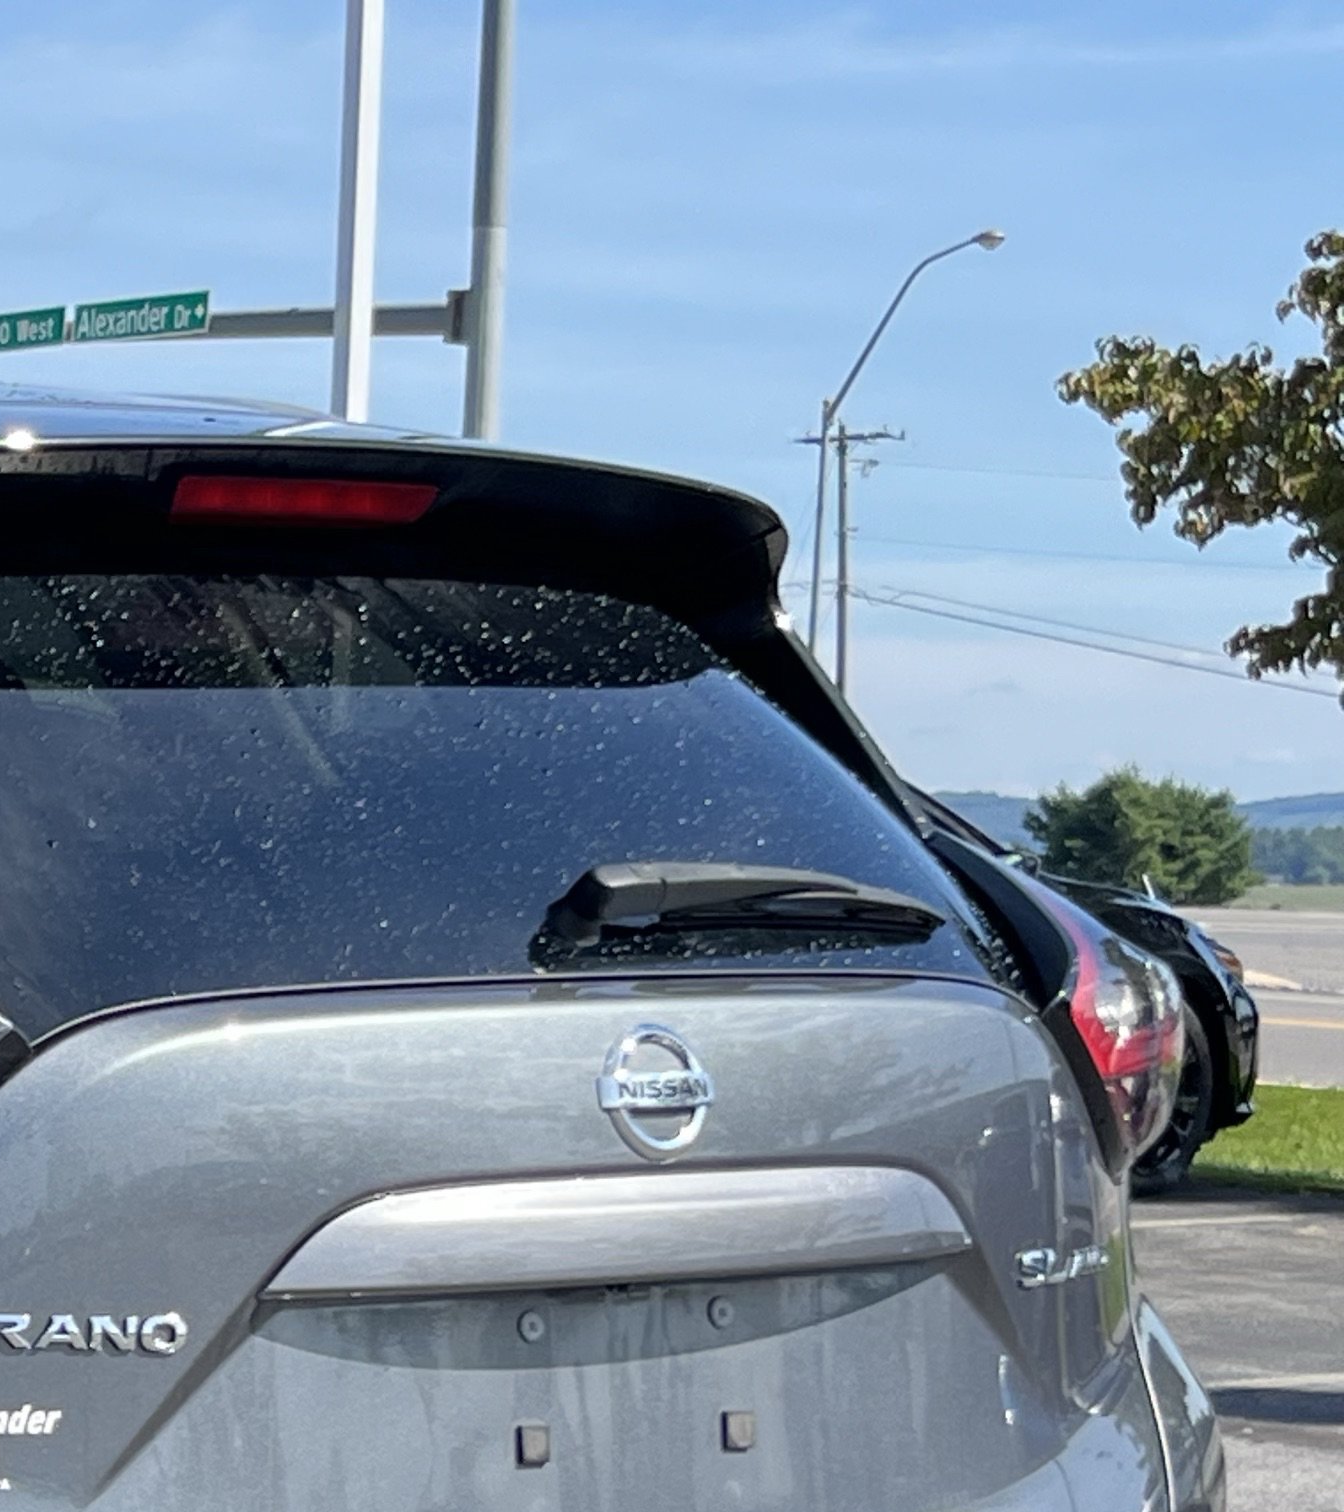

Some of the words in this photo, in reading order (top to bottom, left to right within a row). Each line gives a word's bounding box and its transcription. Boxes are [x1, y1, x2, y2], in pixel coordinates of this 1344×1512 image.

[15, 317, 55, 343] West
[77, 304, 169, 338] Alexander
[173, 304, 192, 329] Dr
[618, 1077, 709, 1098] NISSAN
